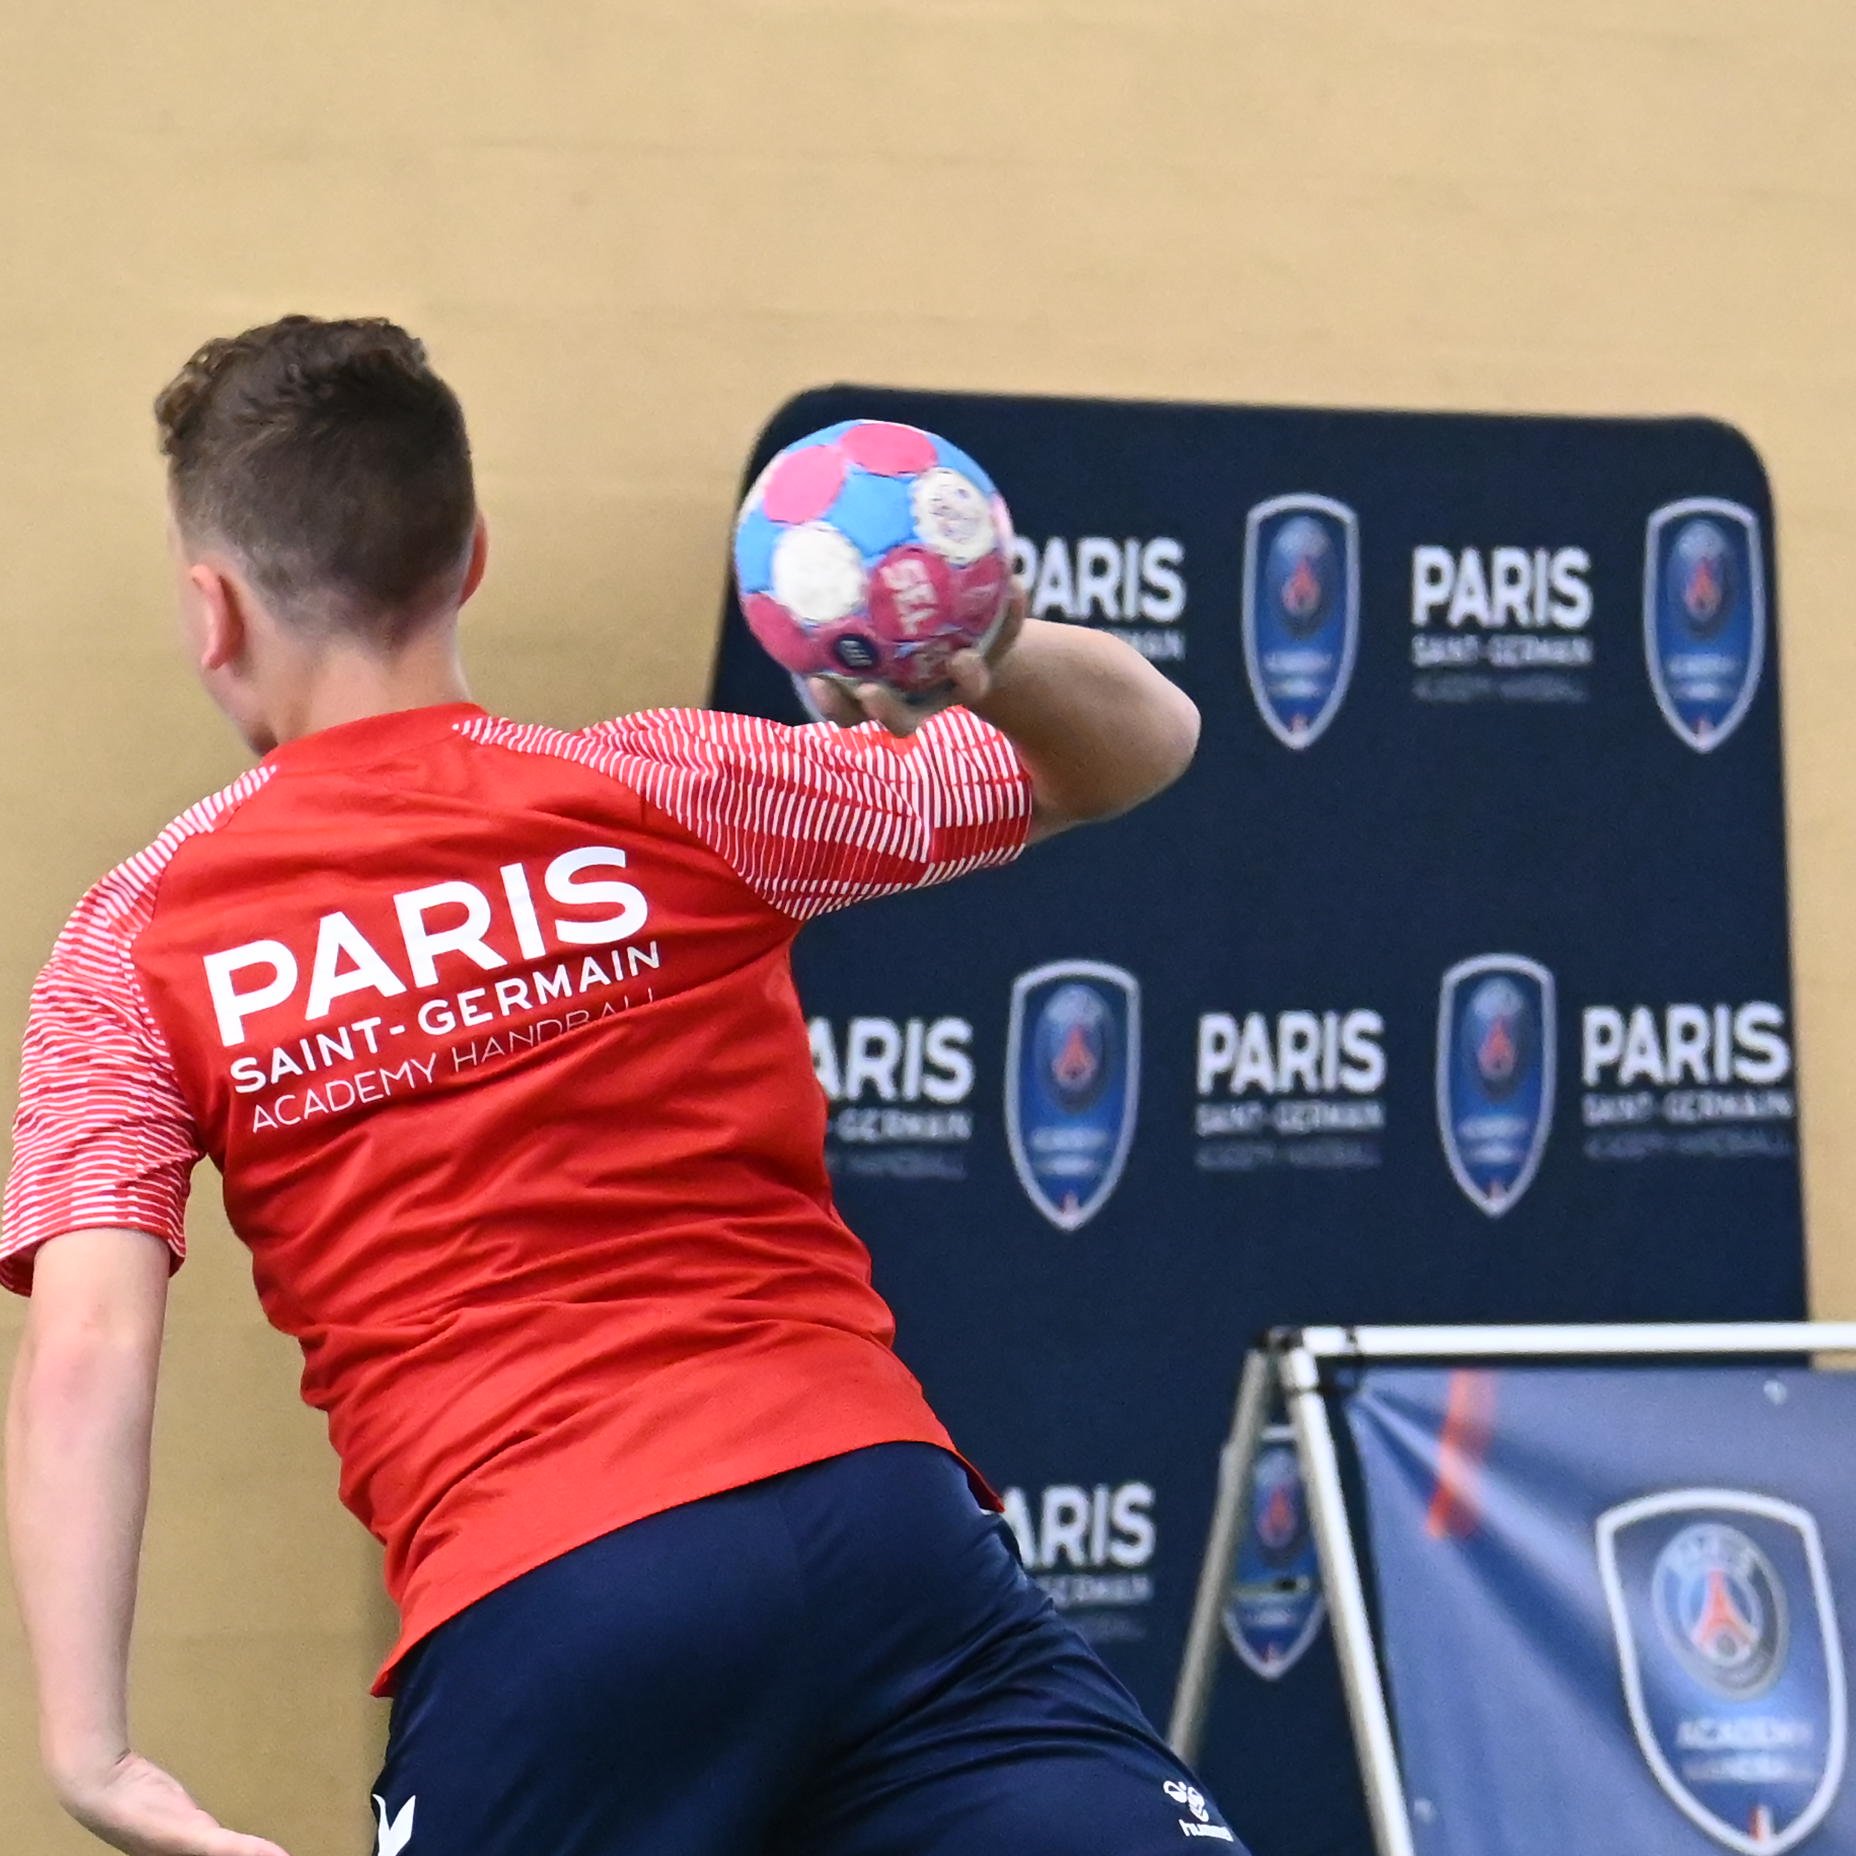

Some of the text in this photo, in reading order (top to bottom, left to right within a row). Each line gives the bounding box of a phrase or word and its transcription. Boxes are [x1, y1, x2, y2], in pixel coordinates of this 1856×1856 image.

[1411, 545, 1594, 630] PARIS
[203, 845, 649, 1047] PARIS
[230, 940, 661, 1094] SAINT-GERMAIN
[806, 1016, 976, 1102] ARIS
[1196, 1008, 1388, 1095] PARIS
[1581, 1001, 1791, 1088] PARIS
[252, 1052, 437, 1134] ACADEMY
[1002, 1481, 1156, 1570] ARIS
